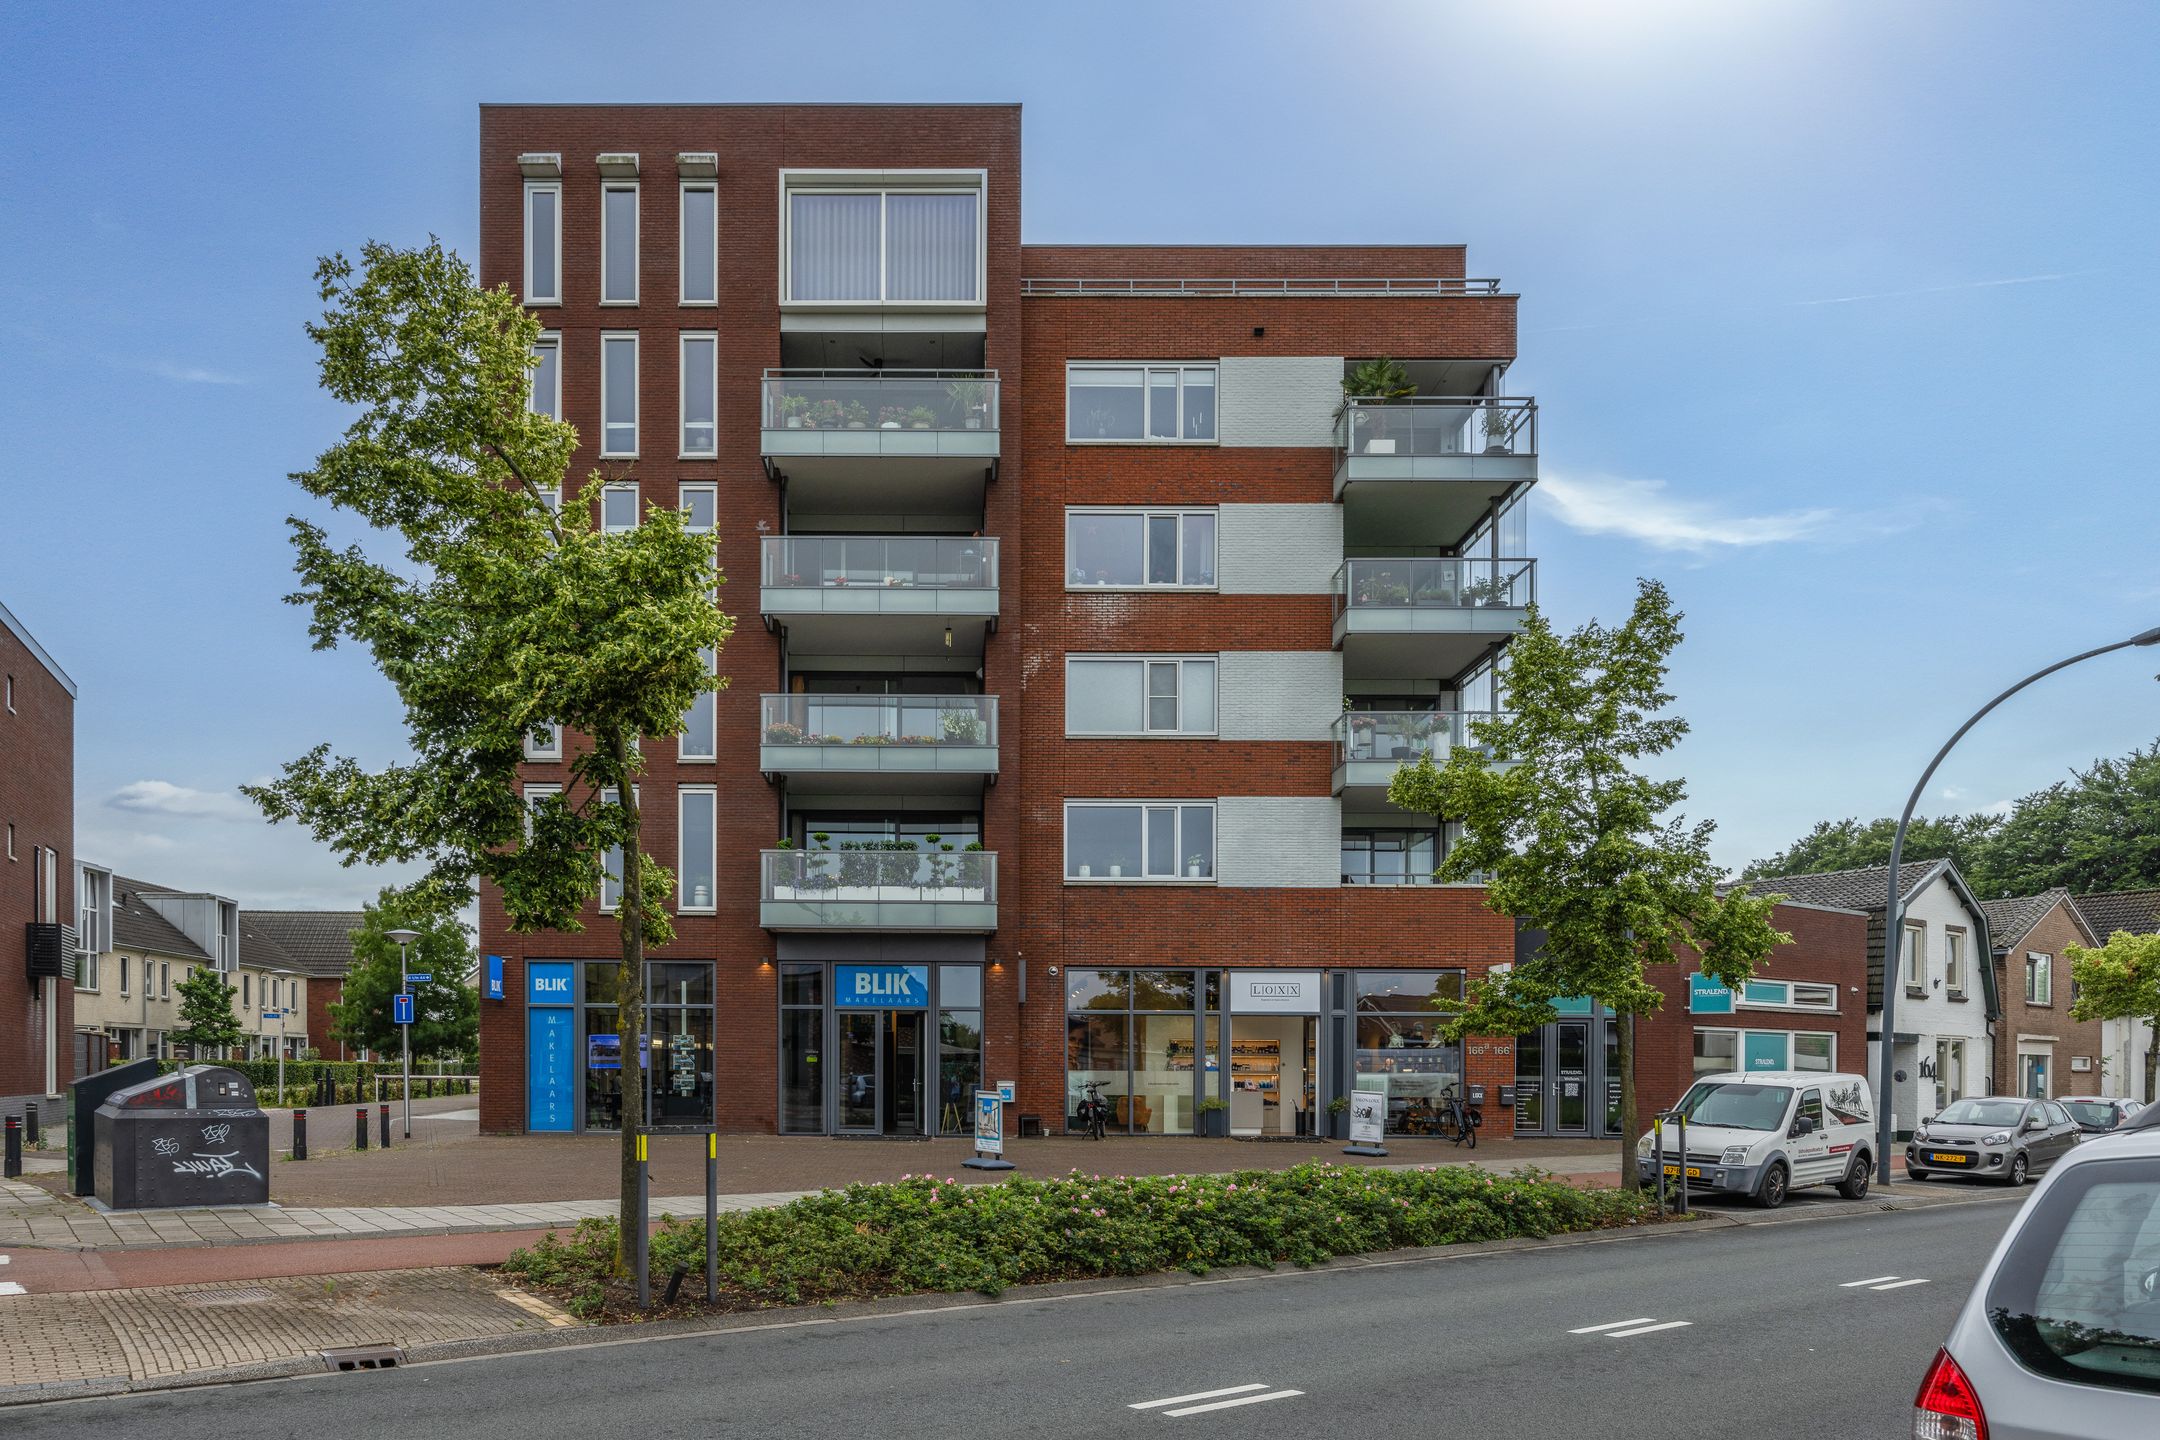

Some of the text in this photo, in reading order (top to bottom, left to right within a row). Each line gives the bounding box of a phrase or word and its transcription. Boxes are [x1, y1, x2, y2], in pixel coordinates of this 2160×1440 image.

[491, 979, 502, 992] BLIK
[536, 978, 567, 991] BLIK
[855, 972, 911, 995] BLIK
[548, 1016, 556, 1123] MAKELAARS
[1919, 1056, 1937, 1084] 164
